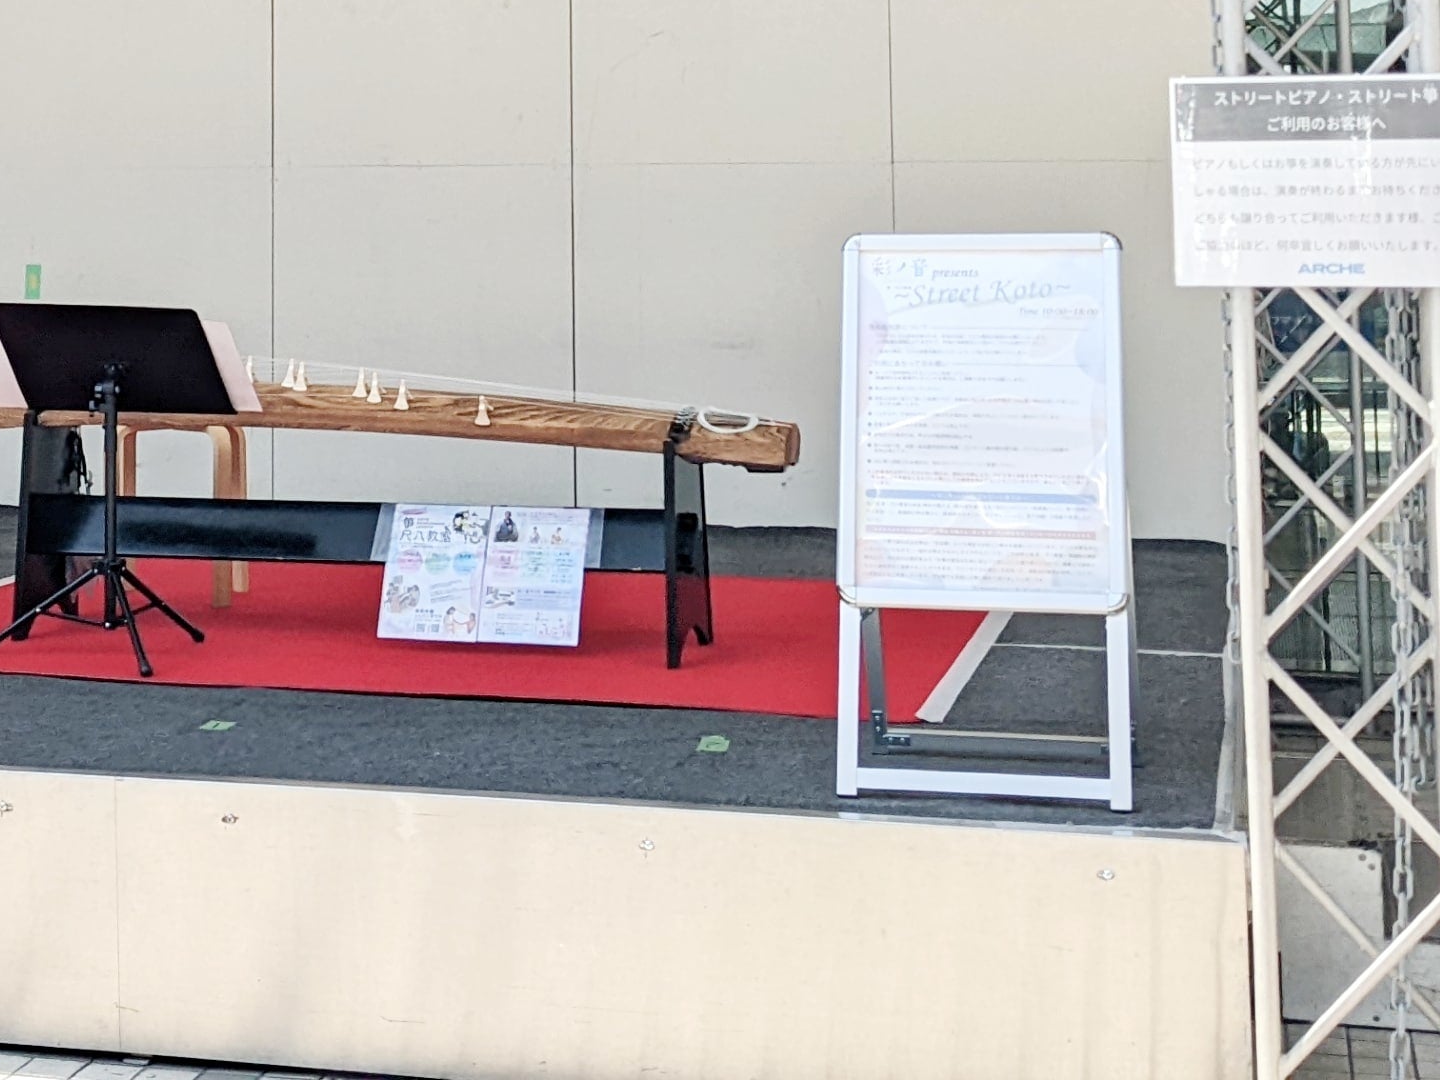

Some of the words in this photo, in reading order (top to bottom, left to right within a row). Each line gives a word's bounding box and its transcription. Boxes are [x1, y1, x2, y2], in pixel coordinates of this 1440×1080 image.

[1266, 116, 1387, 133] ご利用のお客様へ
[931, 268, 980, 281] presents
[1298, 263, 1366, 275] ARCHE
